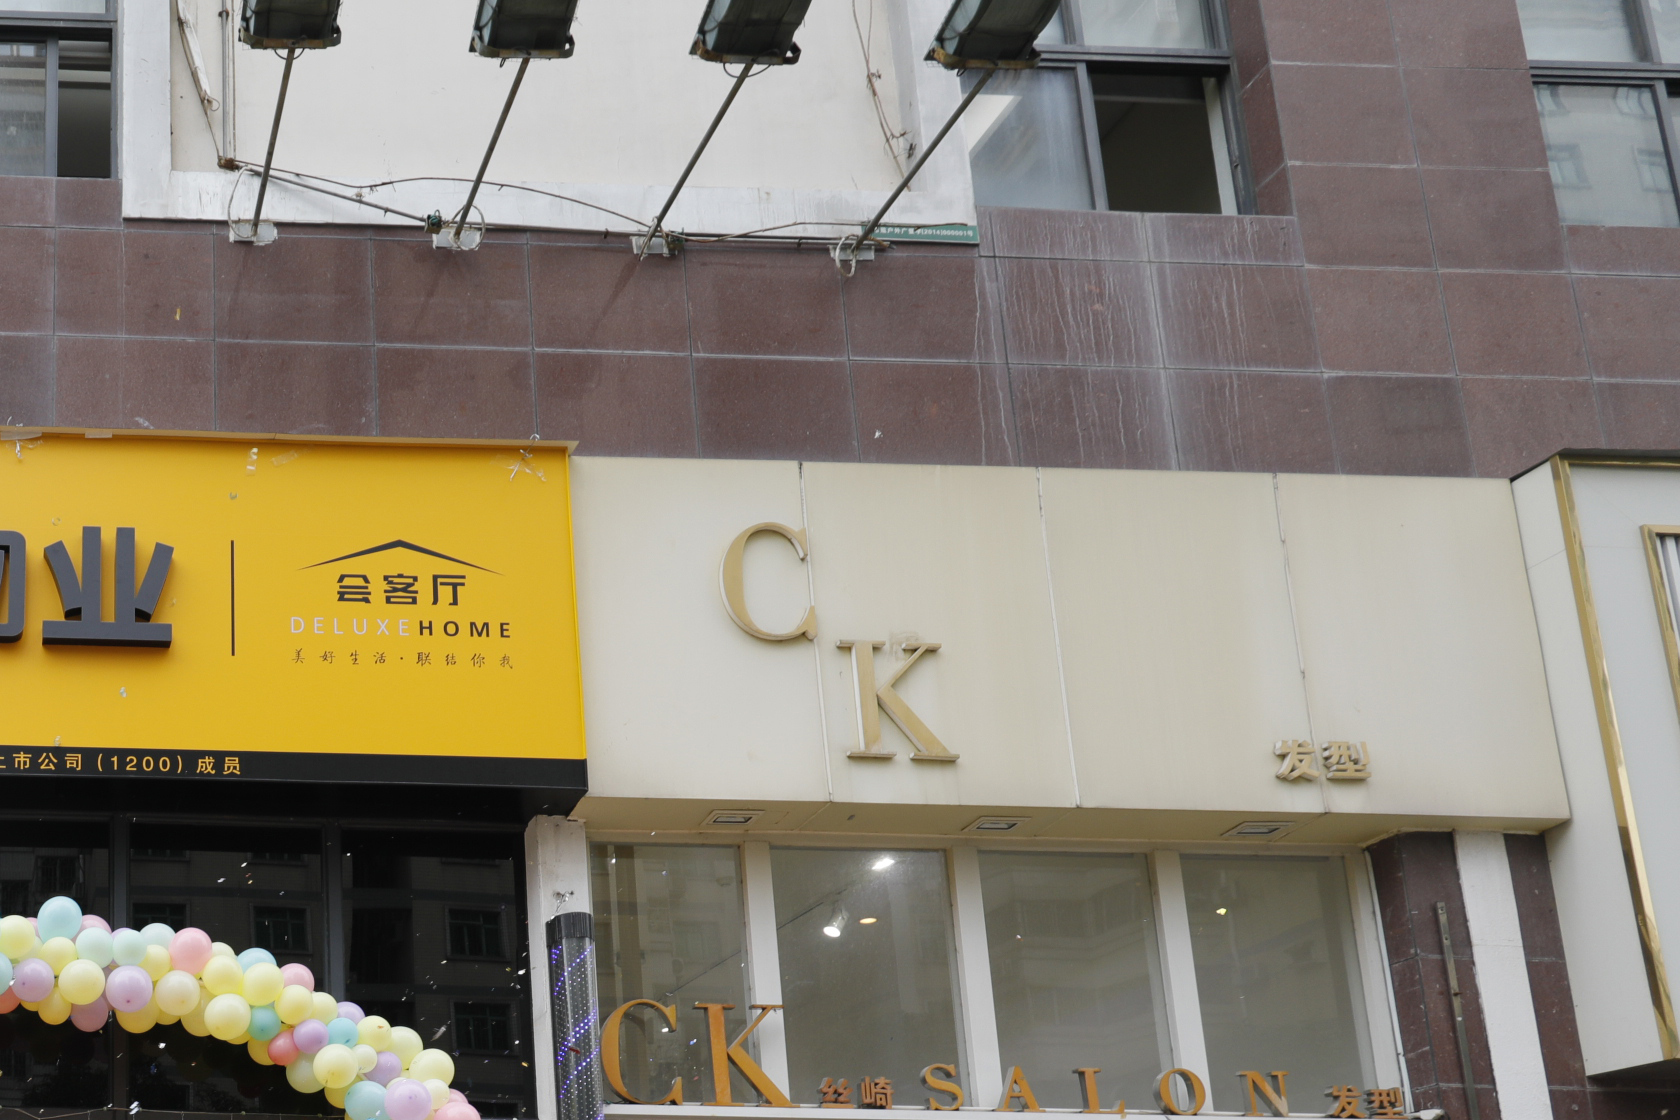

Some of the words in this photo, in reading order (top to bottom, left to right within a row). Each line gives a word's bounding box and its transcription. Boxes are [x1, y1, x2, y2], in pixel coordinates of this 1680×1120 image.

[337, 573, 467, 606] 会客厅
[290, 616, 511, 638] DELUXEHOME
[1274, 740, 1372, 780] 发型
[601, 998, 800, 1107] CK
[819, 1076, 895, 1109] 丝崎
[921, 1063, 1289, 1118] SALON
[1324, 1085, 1409, 1119] 发型
